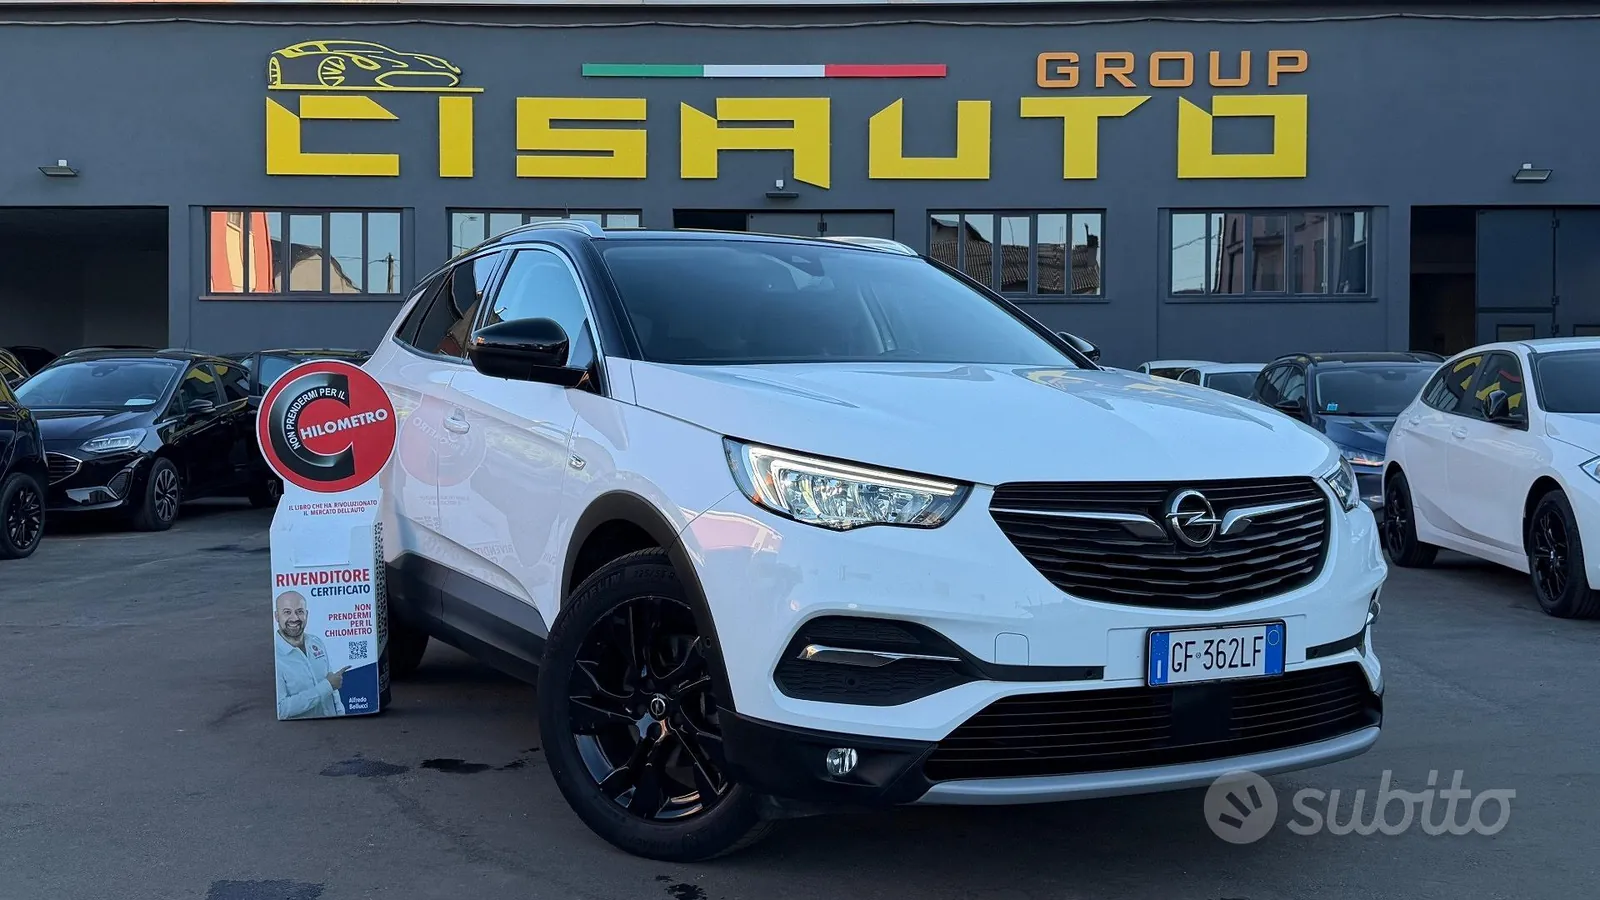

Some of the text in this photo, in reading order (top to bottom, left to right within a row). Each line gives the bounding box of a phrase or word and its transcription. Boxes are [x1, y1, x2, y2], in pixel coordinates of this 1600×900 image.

[1036, 50, 1308, 88] GROUP
[266, 94, 1307, 189] CISAUTO
[286, 387, 346, 450] NON PRENDERMI PER IL
[334, 499, 378, 508] RIVOLUZIONATO
[276, 568, 370, 587] RIVENDITORE
[310, 584, 371, 597] CERTIFICATO
[354, 603, 372, 611] NON
[328, 611, 372, 621] PRENDERMI
[365, 619, 372, 627] IL
[324, 627, 373, 638] CHILOMETRO
[1172, 636, 1264, 673] GF 362LF
[349, 702, 369, 710] Bellucci
